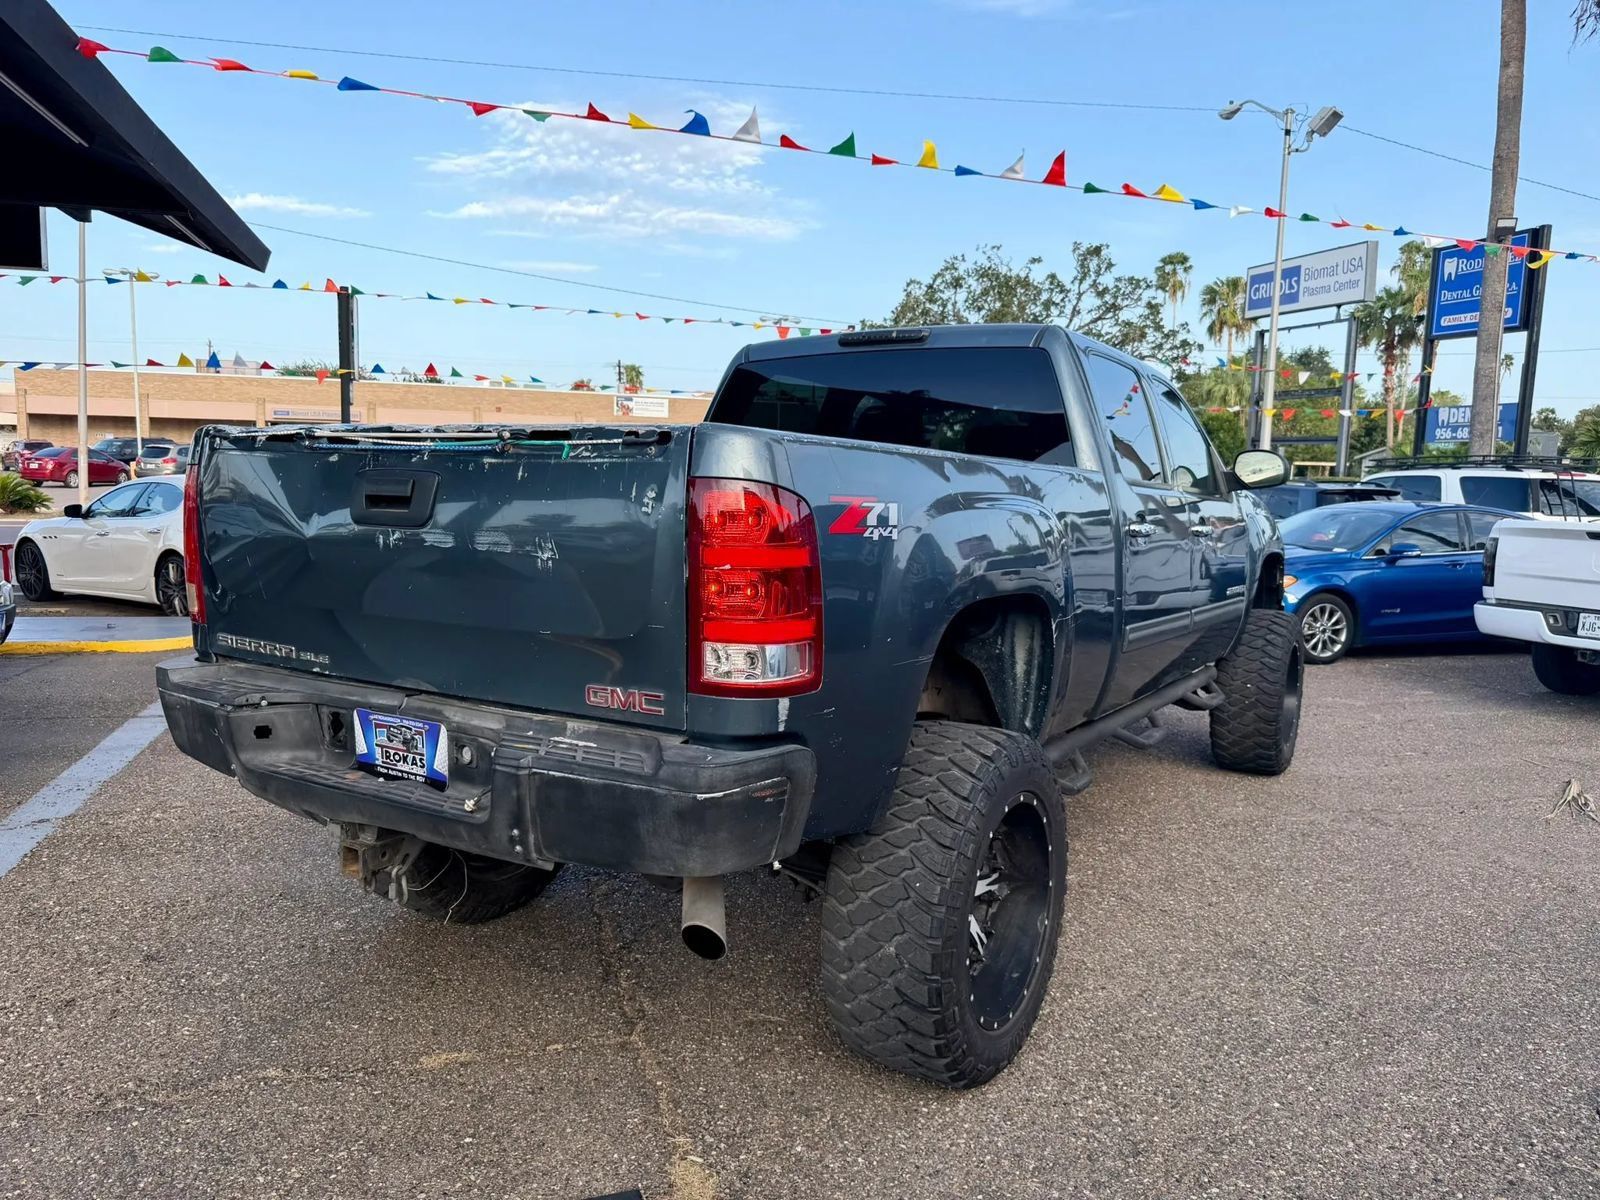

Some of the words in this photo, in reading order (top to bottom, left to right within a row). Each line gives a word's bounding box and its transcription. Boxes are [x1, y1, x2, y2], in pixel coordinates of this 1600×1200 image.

[1304, 262, 1339, 283] Biomat
[1342, 256, 1364, 275] USA
[1250, 277, 1298, 300] GRIOLS
[1302, 283, 1332, 298] Plasma
[1333, 278, 1361, 293] Center
[1443, 315, 1467, 324] FAMILY
[829, 495, 898, 535] Z71
[216, 632, 296, 659] SIERRA
[585, 684, 665, 716] GMC
[379, 746, 425, 768] TROKAS
